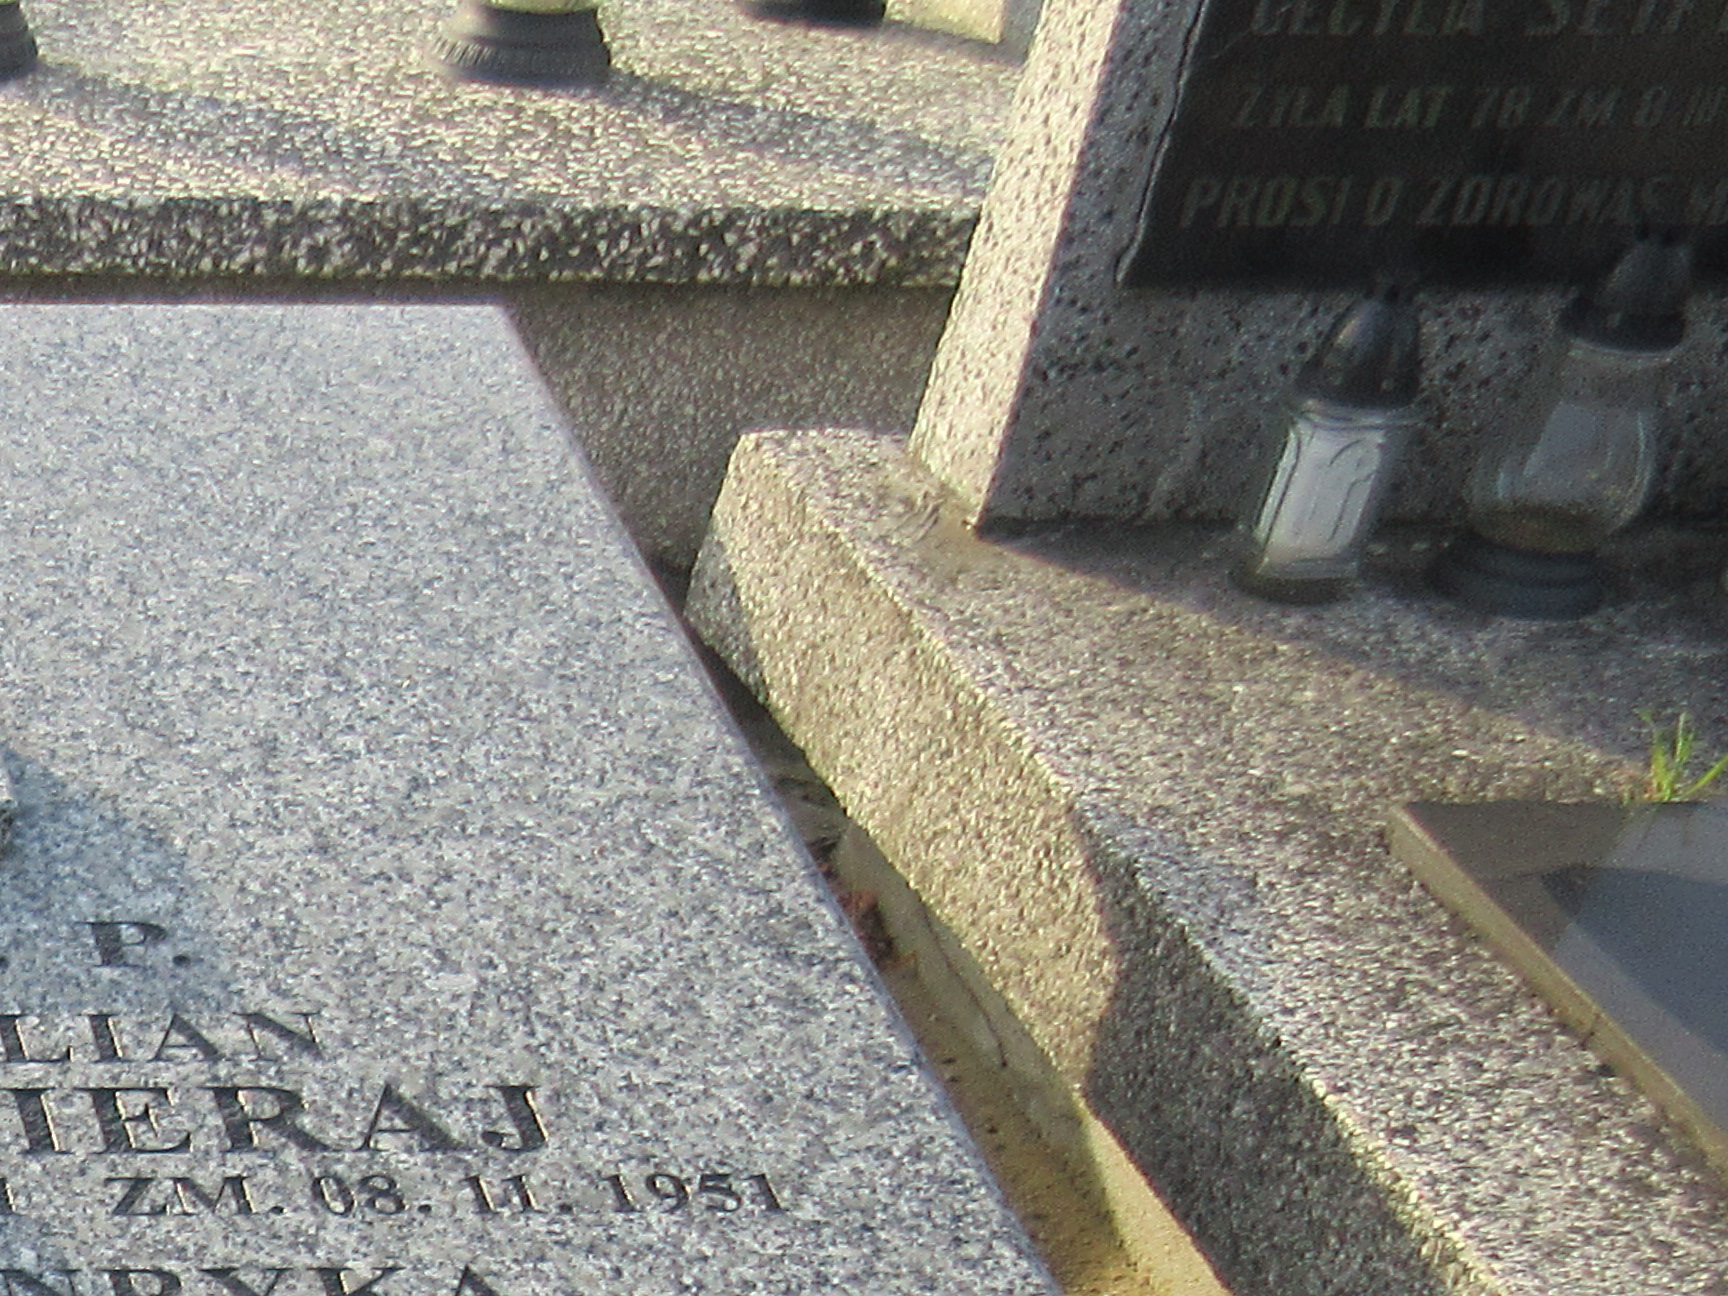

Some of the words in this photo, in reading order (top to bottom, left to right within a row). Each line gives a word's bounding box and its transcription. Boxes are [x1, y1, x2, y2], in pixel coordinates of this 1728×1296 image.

[1364, 84, 1452, 130] LAT
[1179, 176, 1354, 228] PROSI
[77, 920, 193, 968] P.
[104, 1175, 284, 1217] ZM.
